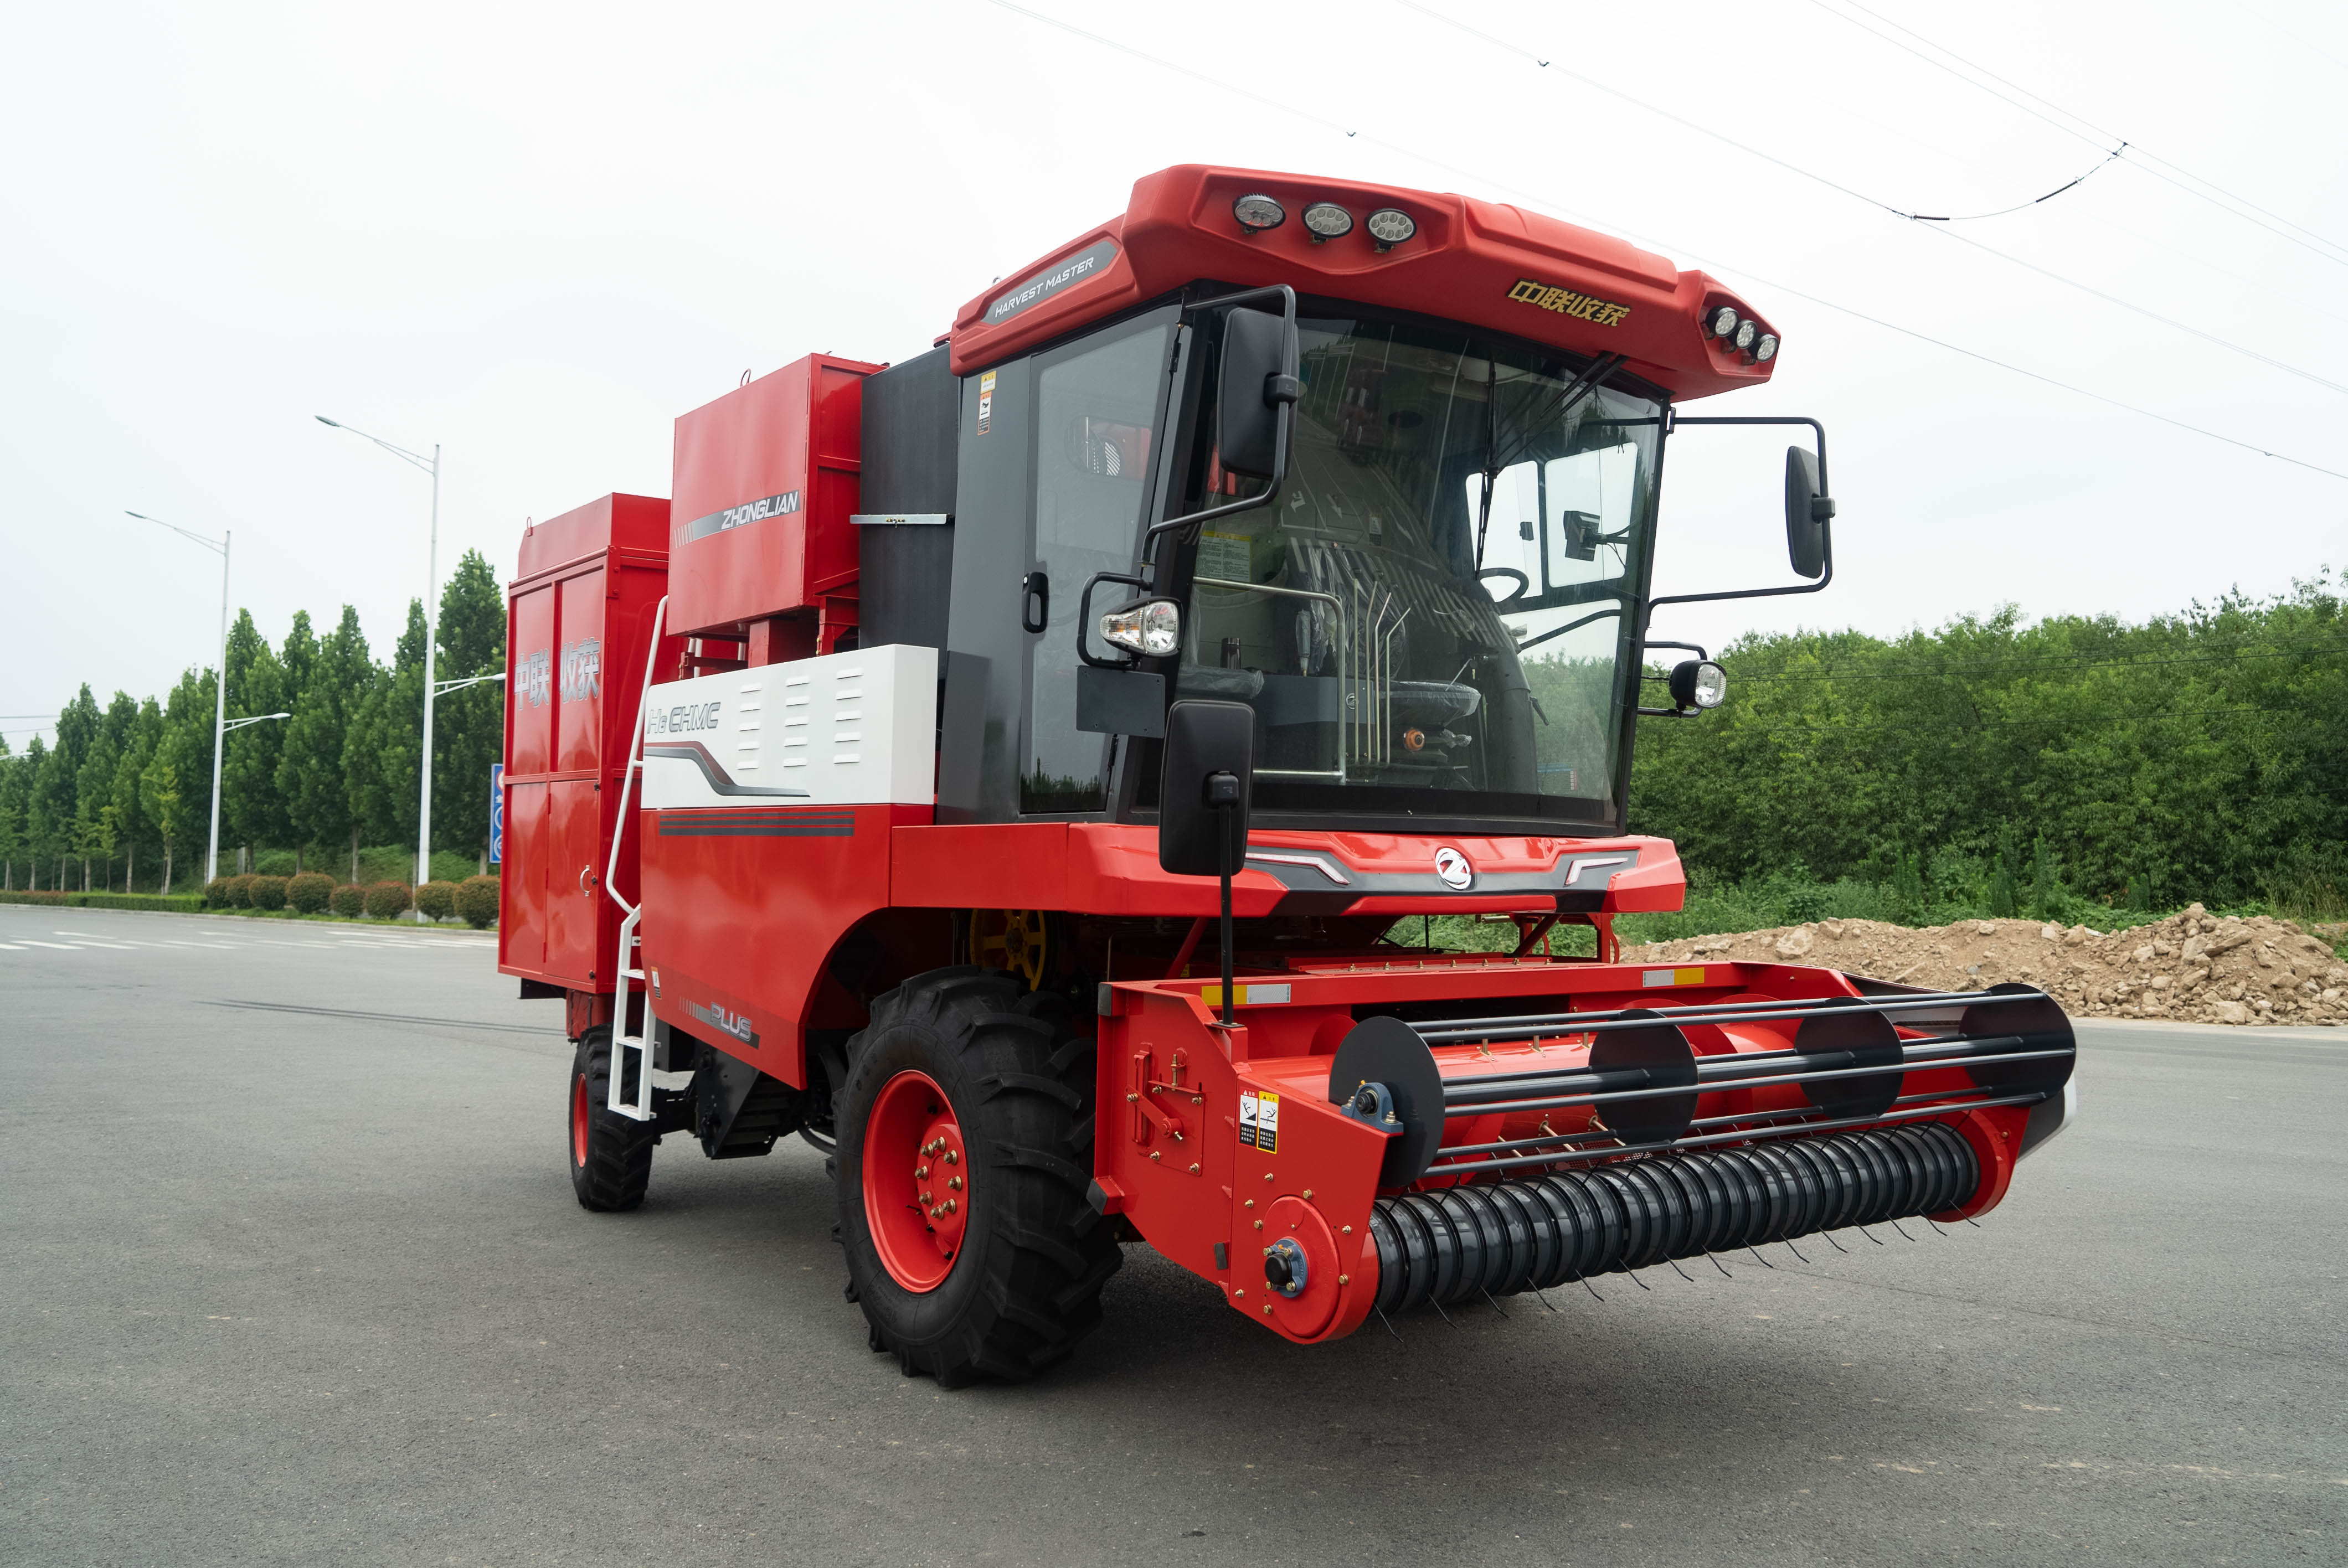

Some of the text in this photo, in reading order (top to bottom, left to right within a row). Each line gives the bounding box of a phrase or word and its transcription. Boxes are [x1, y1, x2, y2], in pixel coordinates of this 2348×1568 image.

[995, 256, 1094, 318] HARVEST MASTER
[1507, 279, 1631, 327] 中联收获
[721, 491, 799, 530] ZHONGLIAN
[669, 702, 721, 733] CHMC
[710, 1002, 753, 1041] PLUS
